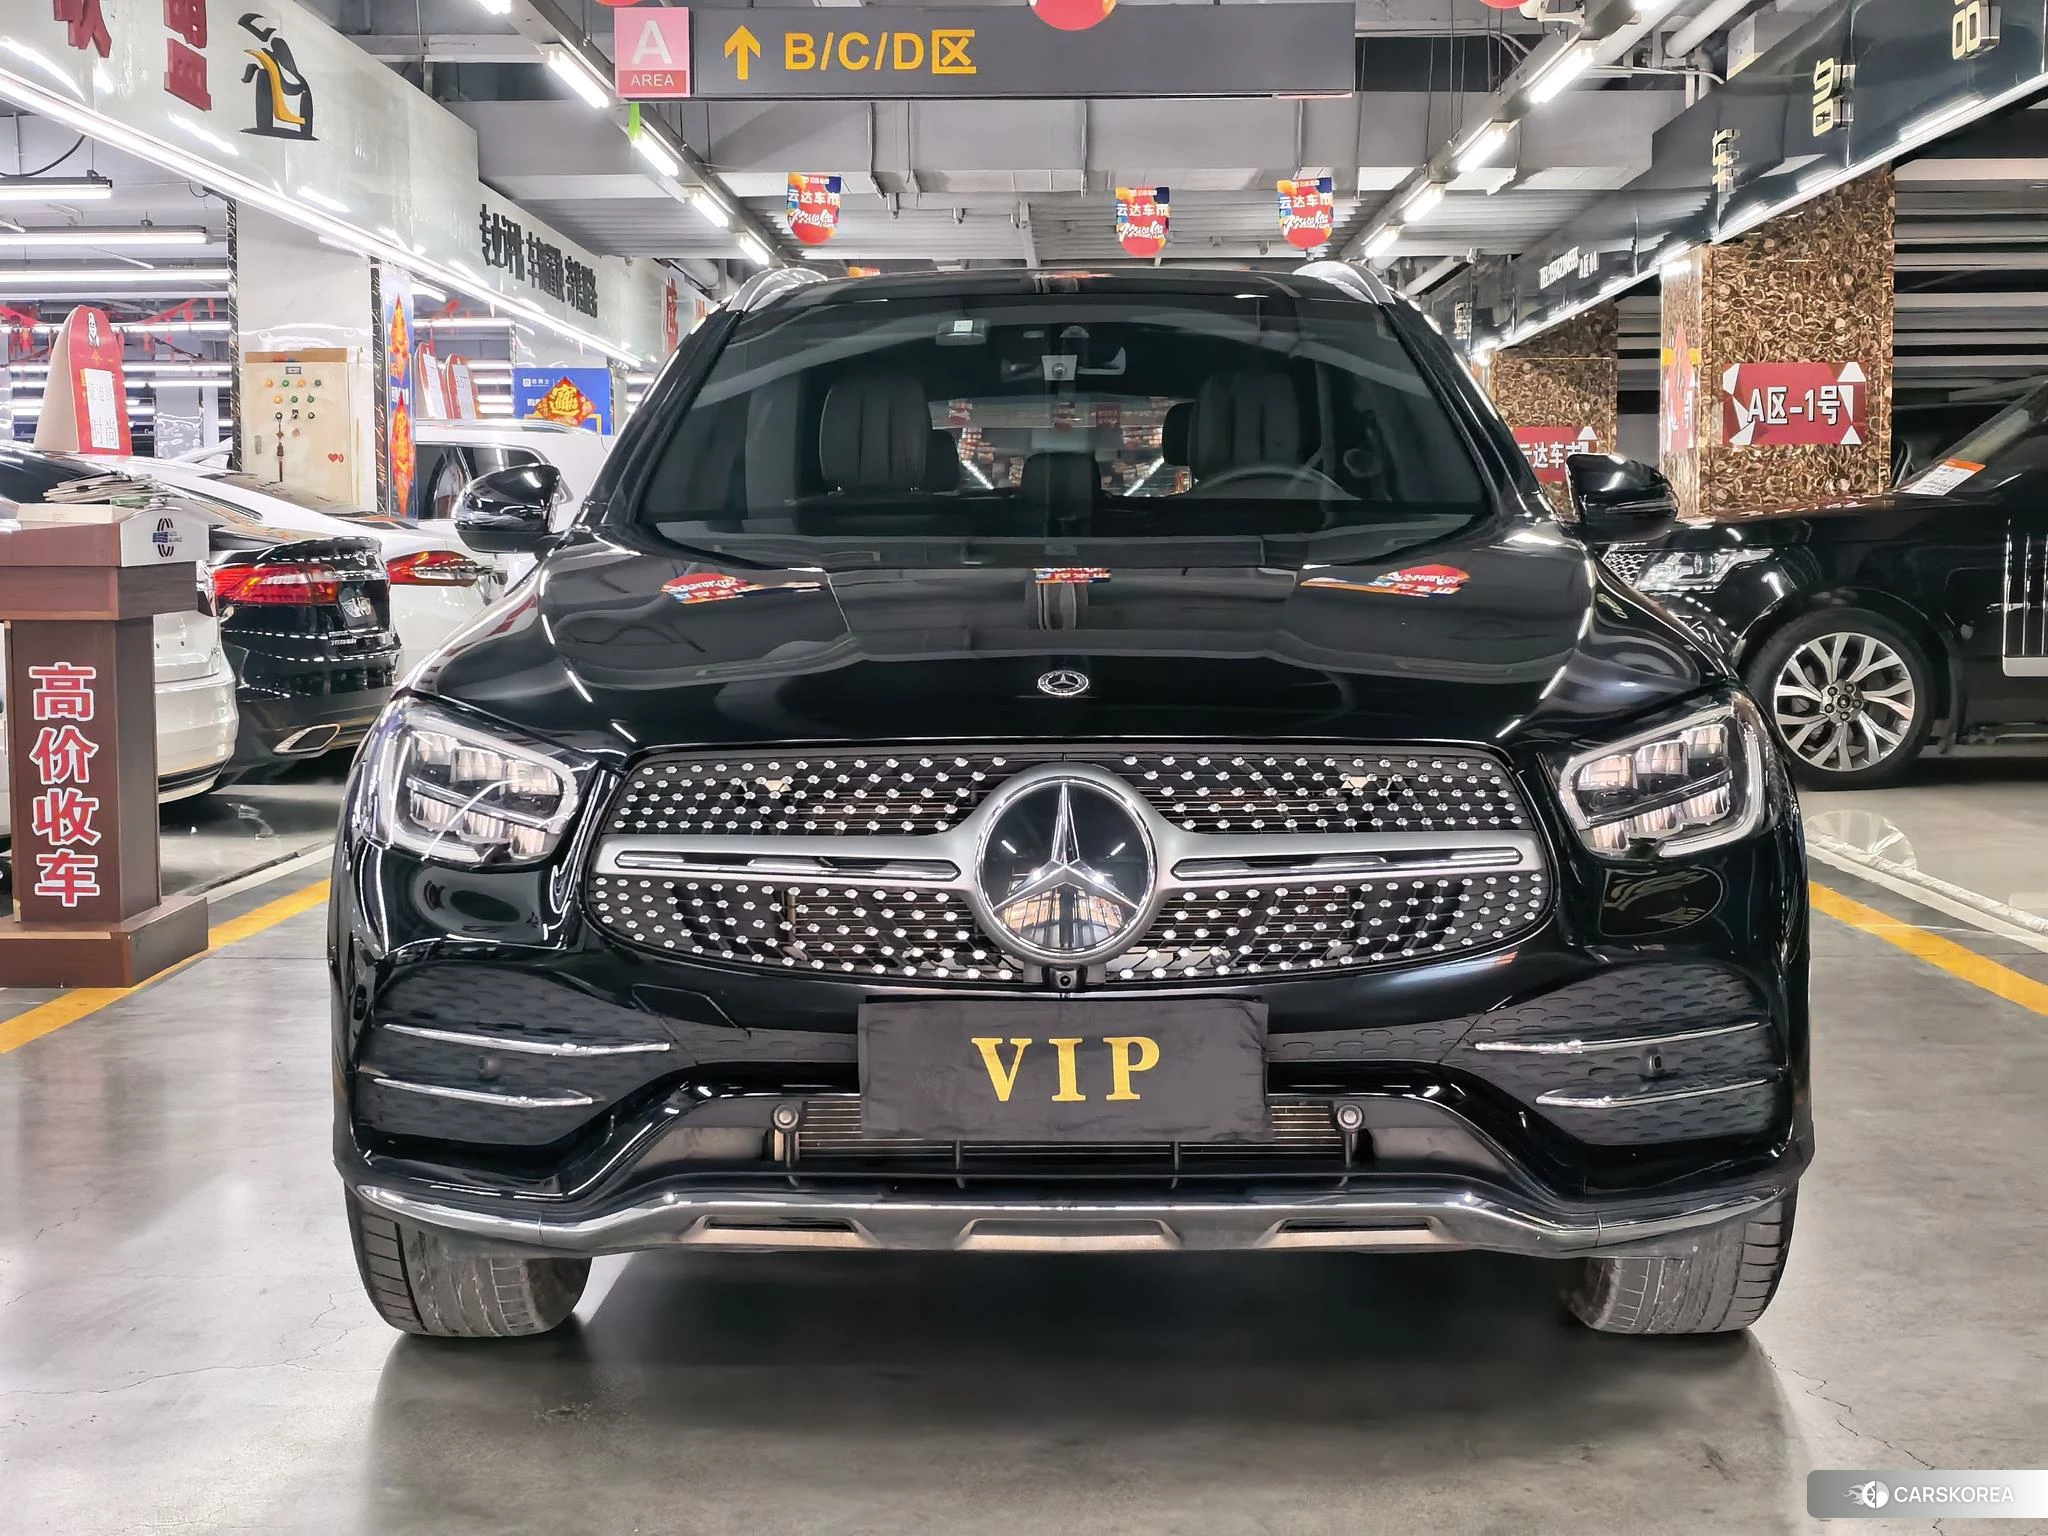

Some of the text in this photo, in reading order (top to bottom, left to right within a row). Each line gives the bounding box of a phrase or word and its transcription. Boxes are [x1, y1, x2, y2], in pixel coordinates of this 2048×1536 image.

[631, 20, 672, 64] A
[785, 29, 976, 74] B/C/D区
[630, 73, 675, 87] AREA
[788, 189, 841, 207] 云达车市
[1117, 203, 1169, 217] 云达车市
[1280, 193, 1335, 208] 云达车市
[1747, 385, 1841, 425] A区-1号
[29, 662, 101, 907] 高价收车
[971, 1036, 1160, 1102] VIP
